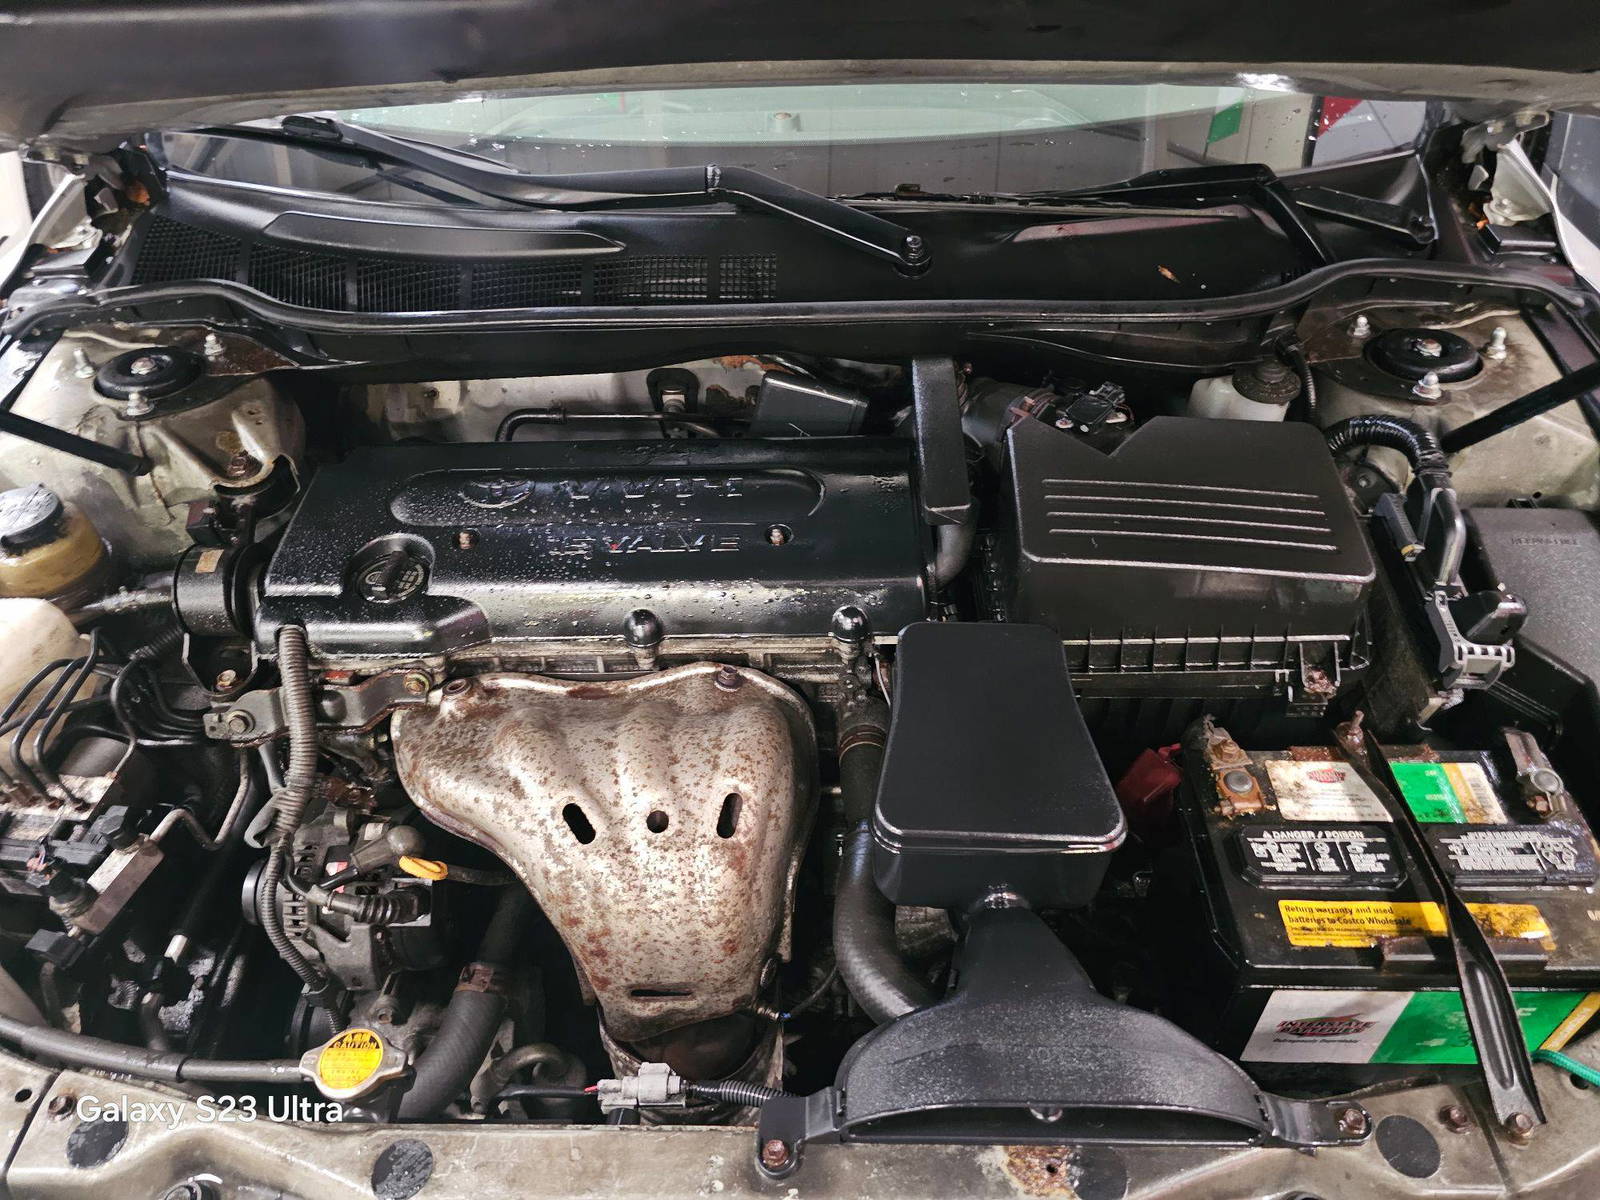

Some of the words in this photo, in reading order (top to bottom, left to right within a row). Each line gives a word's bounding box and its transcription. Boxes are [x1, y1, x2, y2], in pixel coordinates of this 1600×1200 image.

[1272, 831, 1315, 839] DANGER
[1324, 831, 1365, 839] POISON
[1285, 905, 1314, 914] Return
[1315, 906, 1353, 915] warranty
[1355, 906, 1372, 914] and
[1289, 915, 1326, 924] batteries
[1338, 916, 1365, 925] Costco
[1366, 917, 1412, 926] Wholesale
